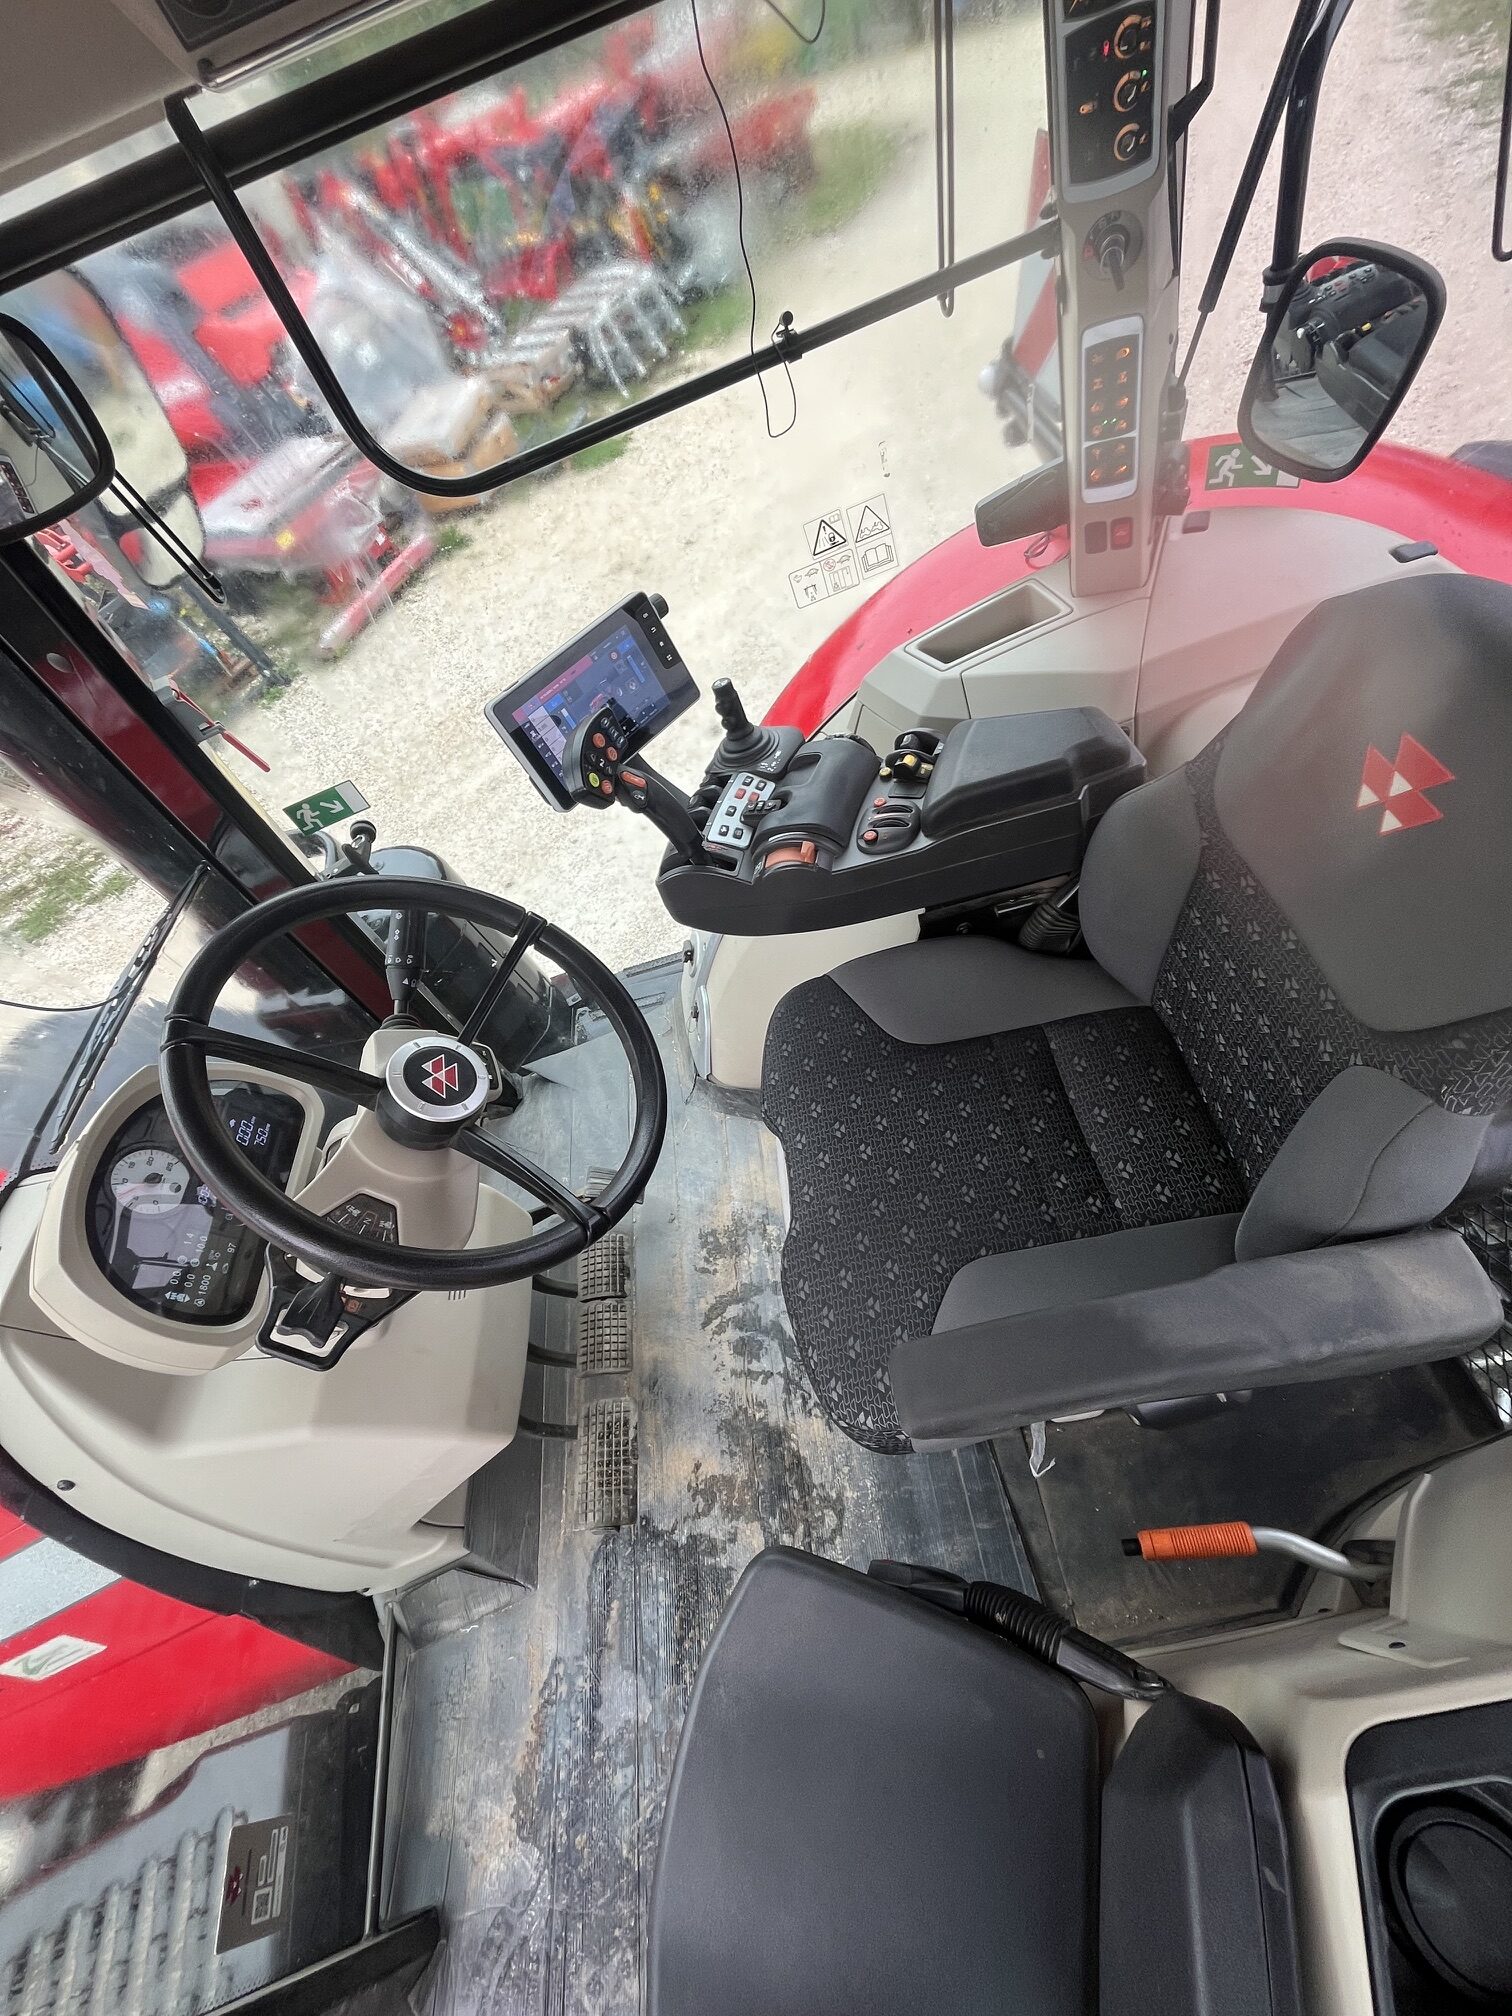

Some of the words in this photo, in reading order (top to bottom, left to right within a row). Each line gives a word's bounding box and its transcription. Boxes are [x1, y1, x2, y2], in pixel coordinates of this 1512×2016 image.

[254, 1128, 269, 1146] 750
[146, 1156, 155, 1167] 20
[165, 1162, 174, 1172] 25
[227, 1243, 237, 1253] 97
[170, 1270, 181, 1284] 0.0
[184, 1274, 195, 1287] 0.0
[199, 1275, 211, 1295] 1800
